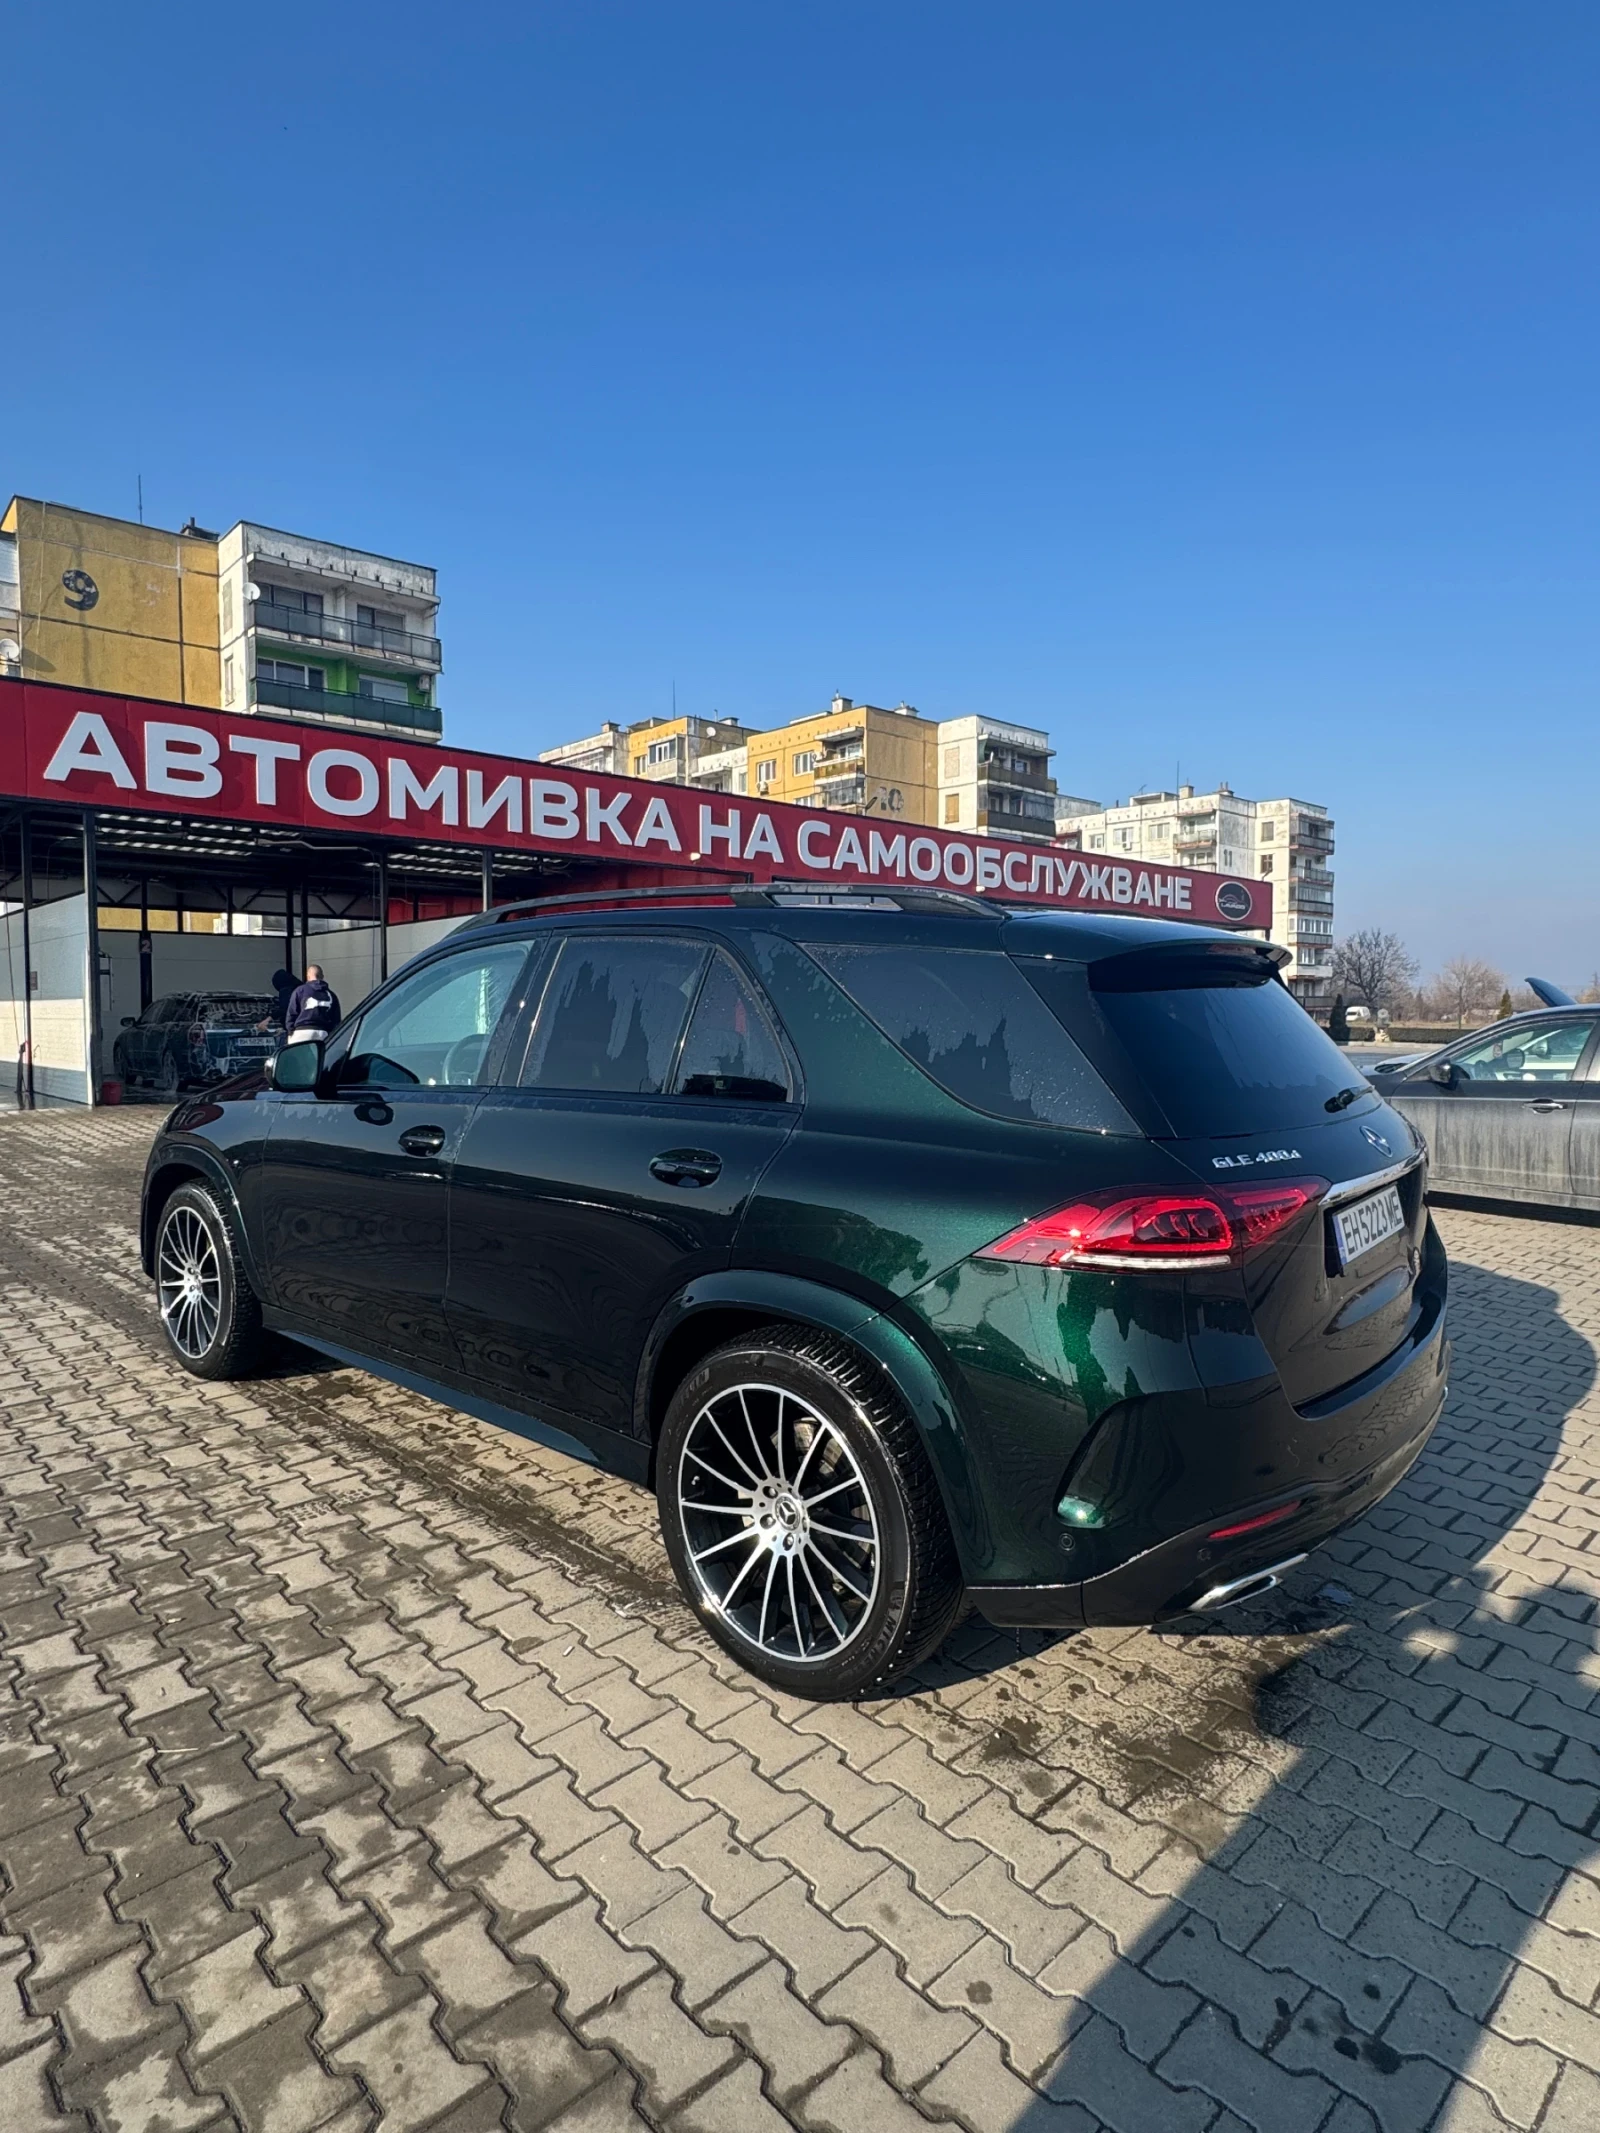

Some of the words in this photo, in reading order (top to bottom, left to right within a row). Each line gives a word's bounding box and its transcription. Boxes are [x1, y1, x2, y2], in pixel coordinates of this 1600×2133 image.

[62, 569, 99, 611] 9
[43, 711, 683, 852] АВТОМИВКА
[699, 803, 784, 864] НА
[797, 820, 1193, 911] САМООБСЛУЖВАНЕ
[141, 939, 151, 952] 2
[1211, 1154, 1254, 1169] GLE
